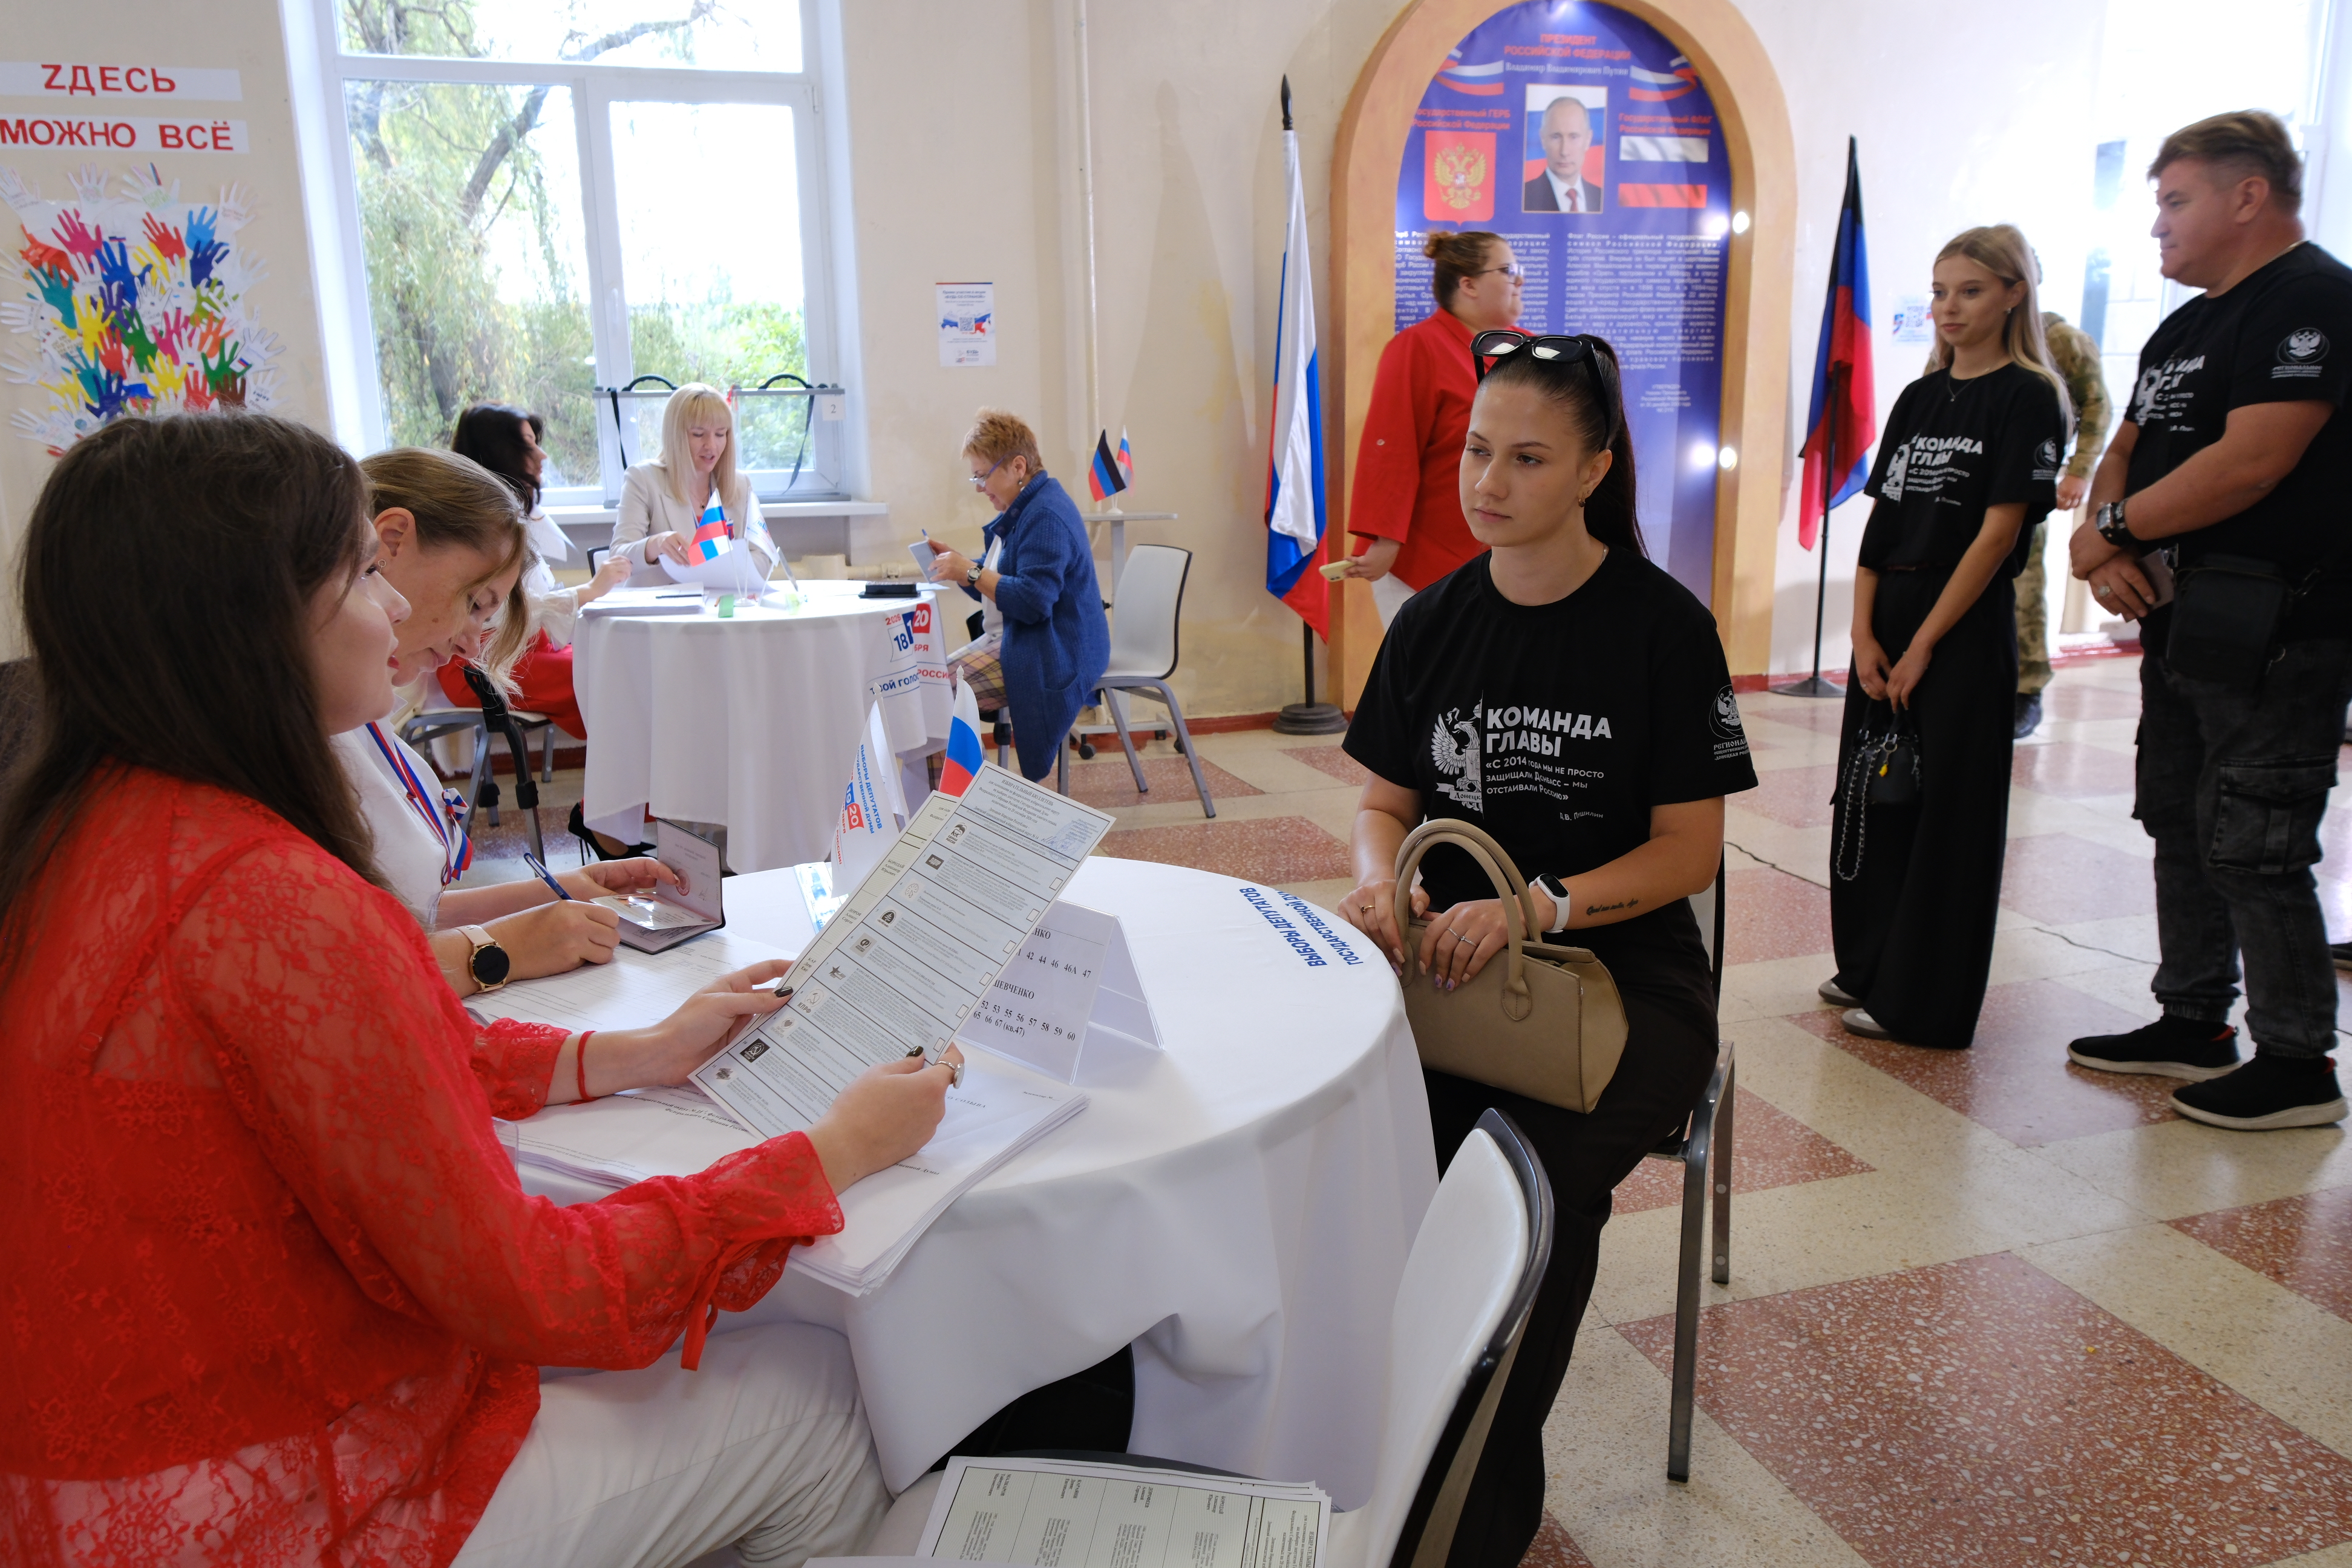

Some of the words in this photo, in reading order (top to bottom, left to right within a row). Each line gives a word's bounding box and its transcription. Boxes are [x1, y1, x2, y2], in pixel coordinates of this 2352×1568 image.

[1540, 34, 1597, 45] ПРЕЗИДЕНТ
[1504, 45, 1571, 57] РОССИЙСКОЙ
[1573, 48, 1631, 60] ФЕДЕРАЦИИ
[1505, 62, 1546, 73] Владимир
[1547, 64, 1602, 76] Владимирович
[1603, 65, 1628, 77] Путин
[41, 64, 175, 96] ZДЕСЬ
[1417, 109, 1486, 117] осударственный
[1489, 109, 1511, 118] ГЕРБ
[1619, 113, 1688, 123] Государственный
[1413, 119, 1462, 128] Российской
[1464, 120, 1510, 129] Федерации
[1619, 125, 1667, 134] Российской
[0, 119, 136, 148] МОЖНО
[158, 122, 234, 151] ВСЁ
[885, 613, 901, 626] 2026
[913, 610, 929, 627] 20
[894, 633, 909, 652] 18
[870, 679, 896, 695] ТОЙ
[918, 669, 950, 679] РОССИ
[1487, 706, 1612, 740] КОМАНДА
[1486, 730, 1561, 757] ГЛАВЫ
[1504, 756, 1527, 767] 2014
[857, 749, 869, 812] ОСУДАРСТВЕННОЙ
[866, 813, 875, 834] ДУМЫ
[860, 744, 869, 780] ВЫБОРЫ
[866, 782, 882, 829] ДЕПУТАТОВ
[1001, 779, 1033, 796] ИЗБИРАТЕЛЬНЫЙ
[1030, 792, 1054, 806] БЮЛЛЕТЕНЬ
[849, 805, 859, 826] 20
[888, 859, 905, 869] БОРОДАЙ
[1239, 887, 1296, 929] ДЕПУТАТОВ
[1285, 898, 1364, 965] ГОСУДАРСТВЕННОЙ
[1279, 930, 1328, 967] ВЫБОРЫ
[1027, 952, 1034, 960] 42
[1039, 955, 1047, 964] 44
[1051, 959, 1059, 968] 46
[1064, 964, 1077, 974] 46А
[1083, 970, 1091, 978] 47
[797, 1002, 811, 1013] КПРФ
[981, 1001, 988, 1009] 52
[993, 1005, 1001, 1013] 53
[1004, 1008, 1012, 1018] 55
[1016, 1013, 1025, 1022] 56
[1029, 1018, 1037, 1027] 57
[1041, 1022, 1050, 1031] 58
[1054, 1027, 1062, 1036] 59
[1067, 1032, 1076, 1040] 60
[985, 1015, 992, 1024] 66
[955, 1097, 986, 1108] СОЗЫВА
